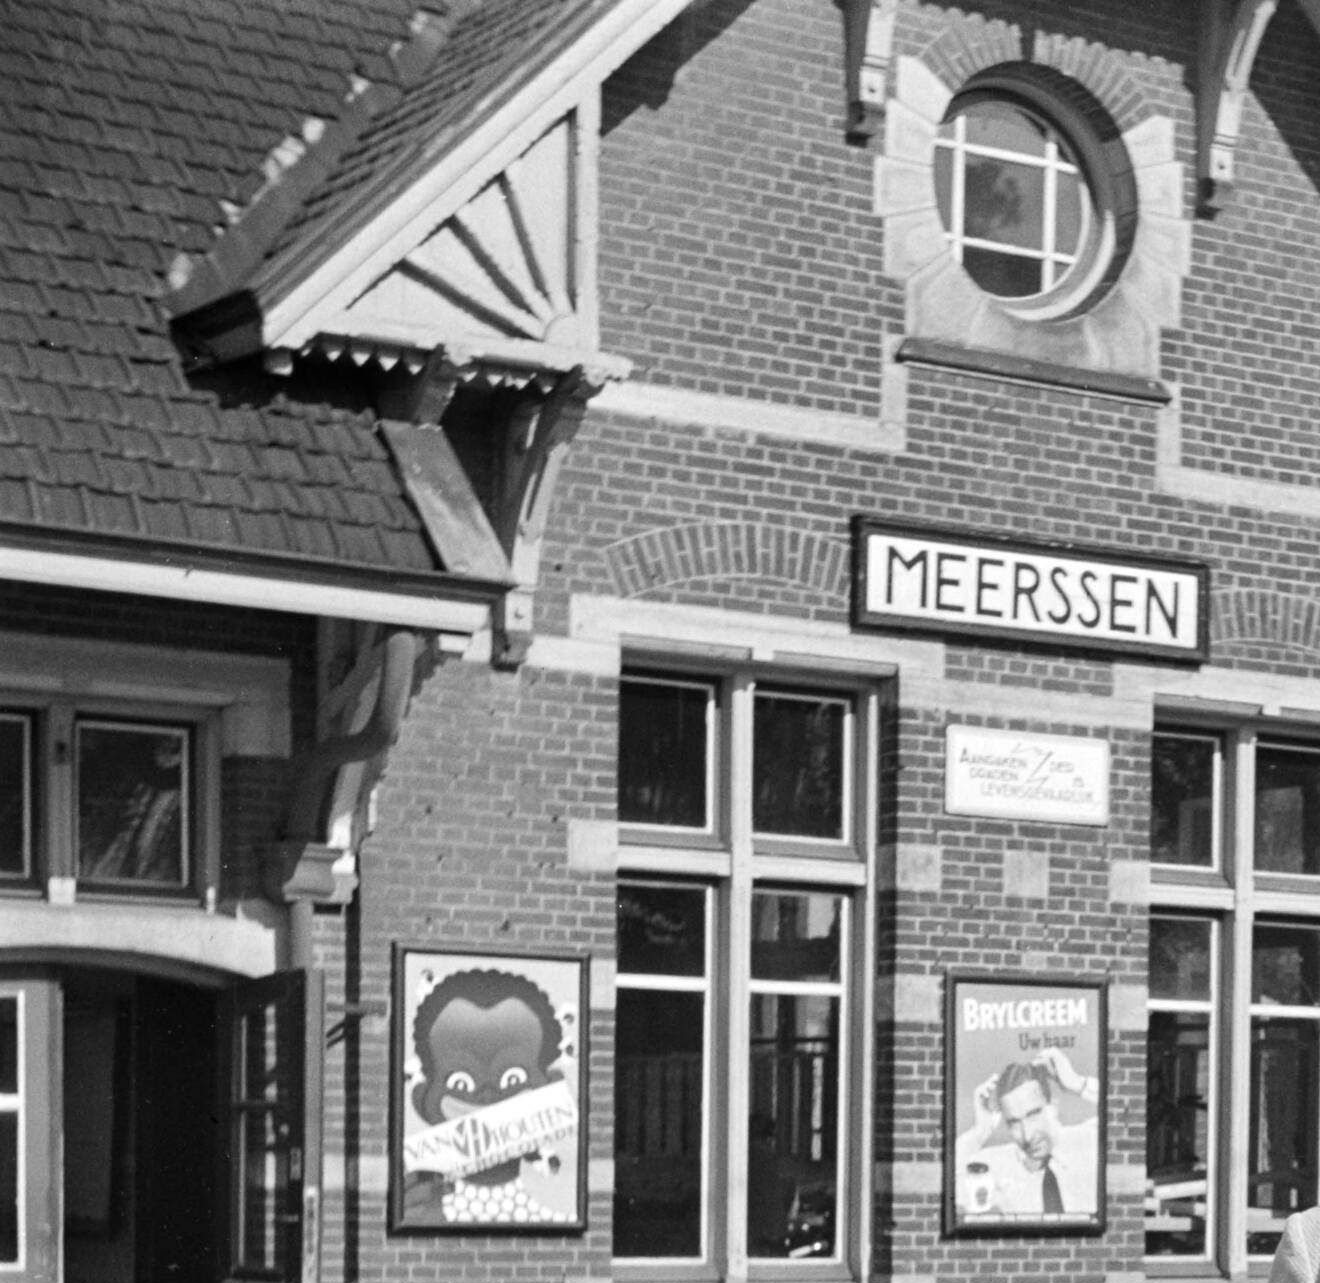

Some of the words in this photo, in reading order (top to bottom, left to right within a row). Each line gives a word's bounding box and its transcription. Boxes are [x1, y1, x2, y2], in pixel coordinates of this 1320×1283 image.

[886, 545, 1180, 639] MEERSSEN
[963, 998, 1088, 1032] BRYLCREEM
[1019, 1033, 1041, 1050] Uw
[1044, 1033, 1076, 1049] haar
[491, 1106, 574, 1147] HOUTEN
